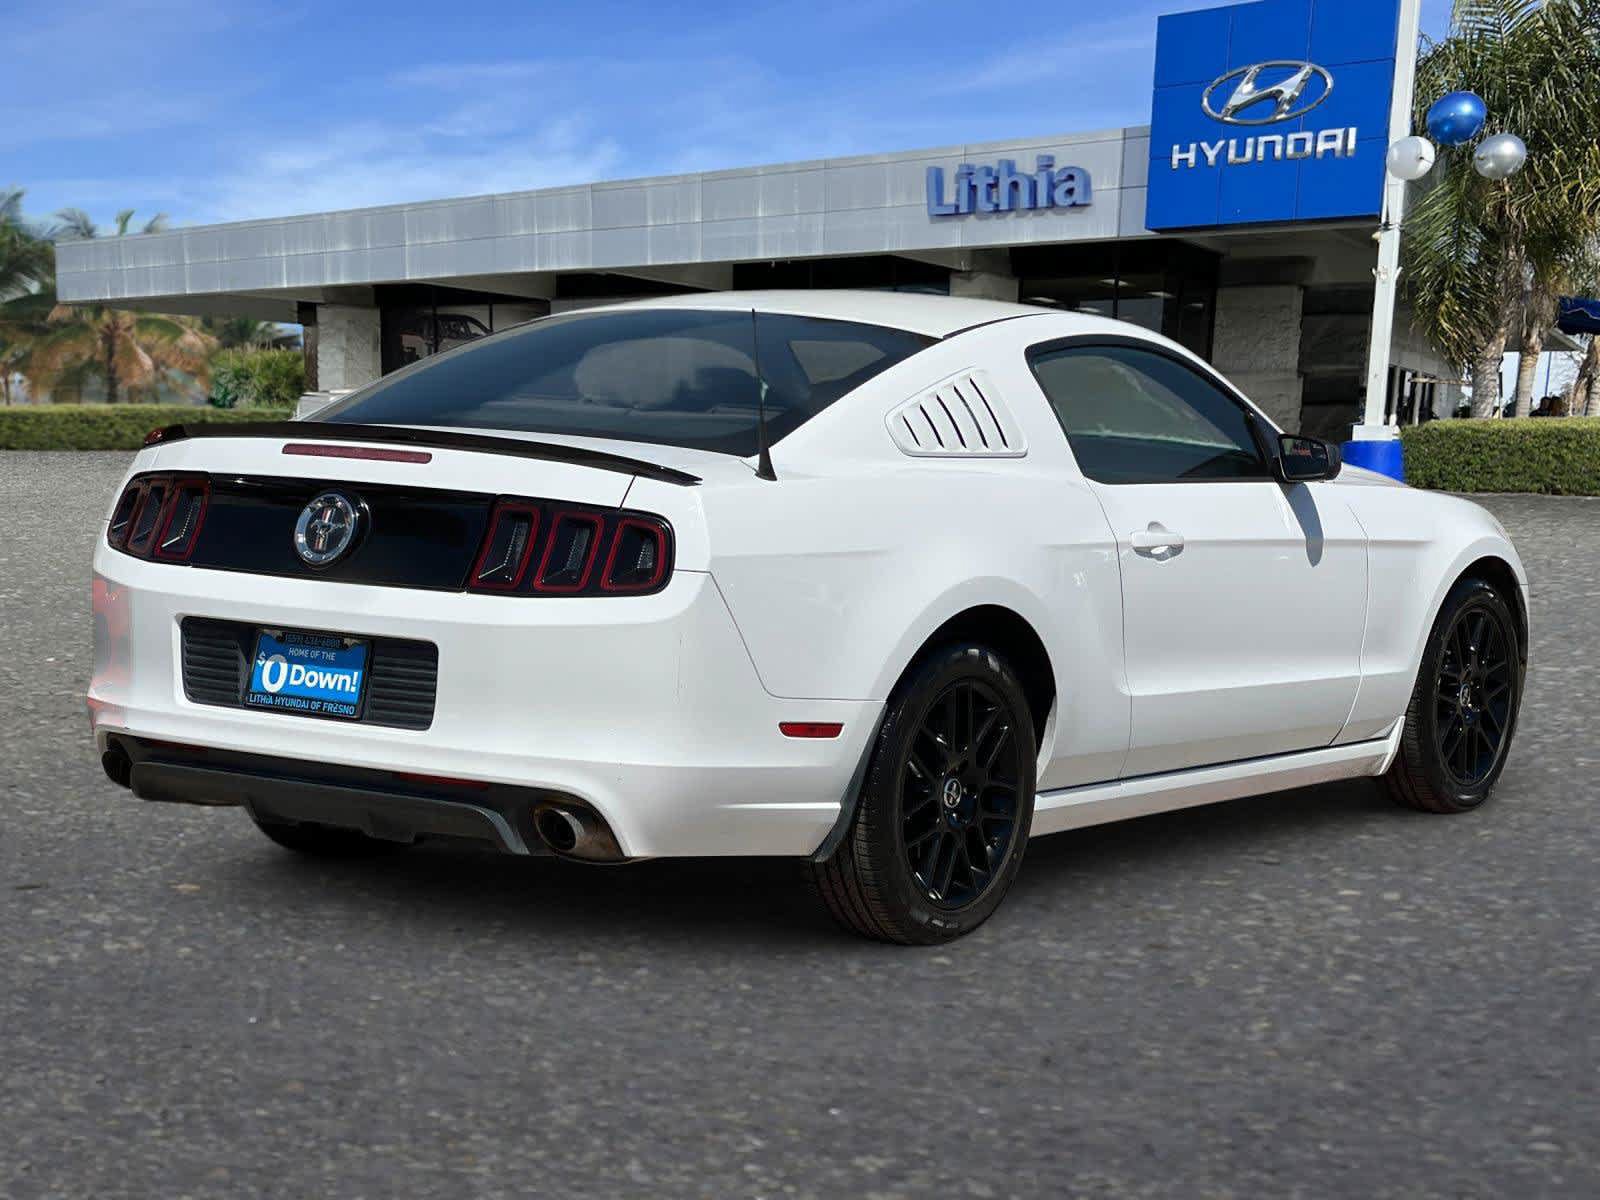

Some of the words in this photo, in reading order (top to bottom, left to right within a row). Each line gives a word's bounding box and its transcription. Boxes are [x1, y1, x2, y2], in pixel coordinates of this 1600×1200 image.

[1171, 127, 1357, 169] HYUNDAI
[926, 154, 1092, 217] Lithia
[288, 647, 309, 658] HOME
[310, 651, 320, 660] OF
[321, 651, 337, 661] THE
[289, 664, 359, 693] Down!
[249, 693, 274, 706] LITHIA
[275, 696, 308, 709] HYUNDAI
[310, 701, 322, 711] OF
[323, 702, 355, 715] FRESNO
